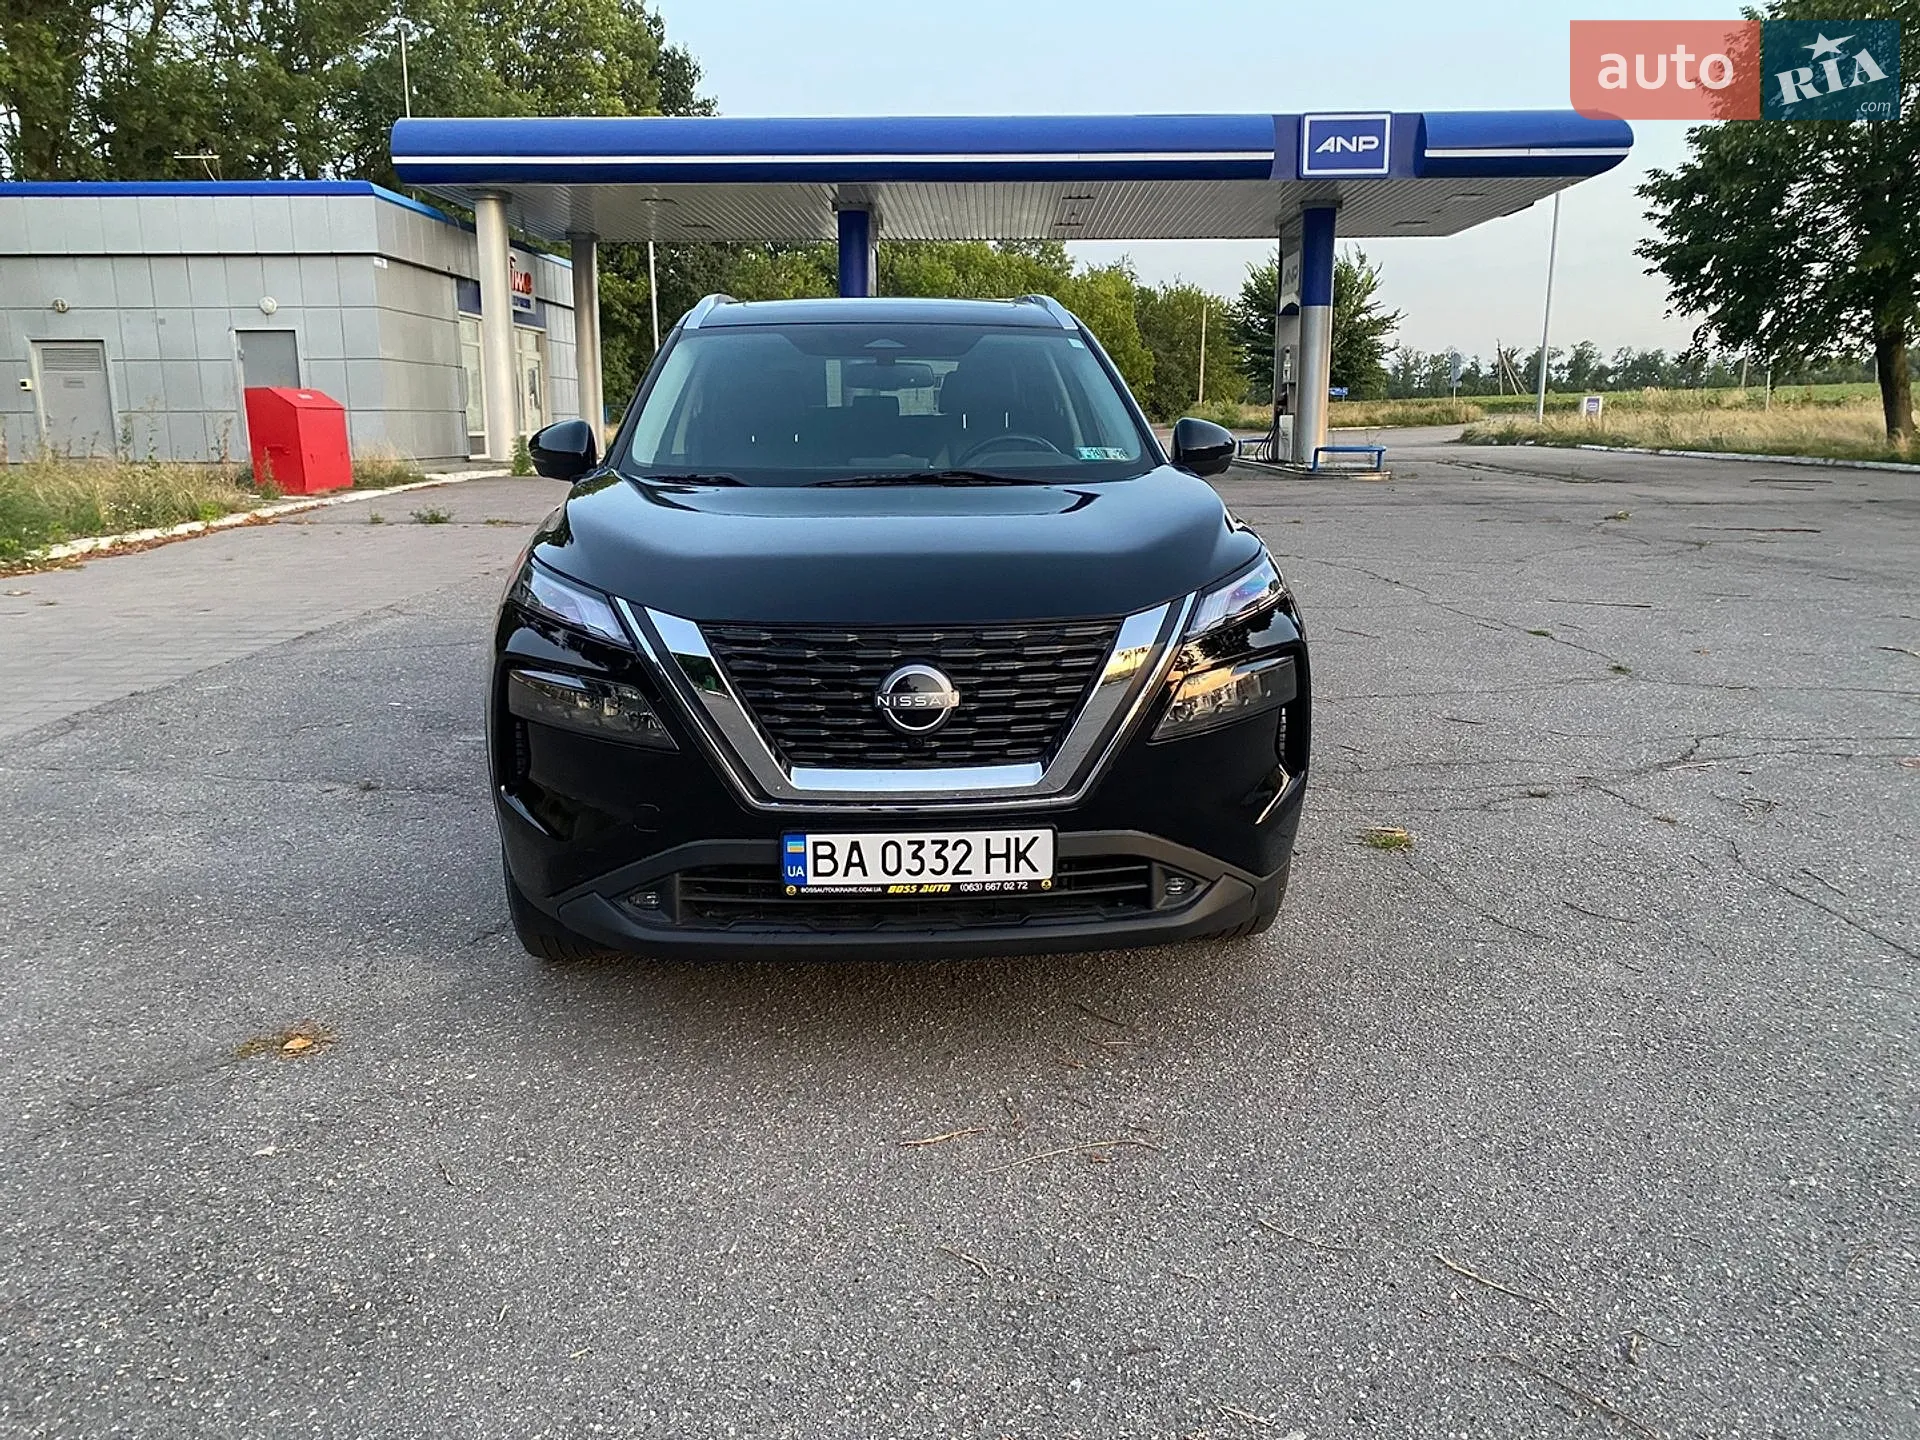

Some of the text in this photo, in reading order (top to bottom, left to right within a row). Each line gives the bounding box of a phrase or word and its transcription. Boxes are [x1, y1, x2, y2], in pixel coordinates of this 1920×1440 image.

[1315, 135, 1380, 153] ANP
[811, 836, 1040, 878] BA 0332 HK
[787, 865, 806, 877] UA
[887, 885, 918, 894] BOSS
[919, 884, 952, 893] AUTO
[960, 882, 983, 892] (063)
[985, 882, 1001, 891] 667
[1003, 881, 1015, 890] 02
[1017, 881, 1029, 890] 72
